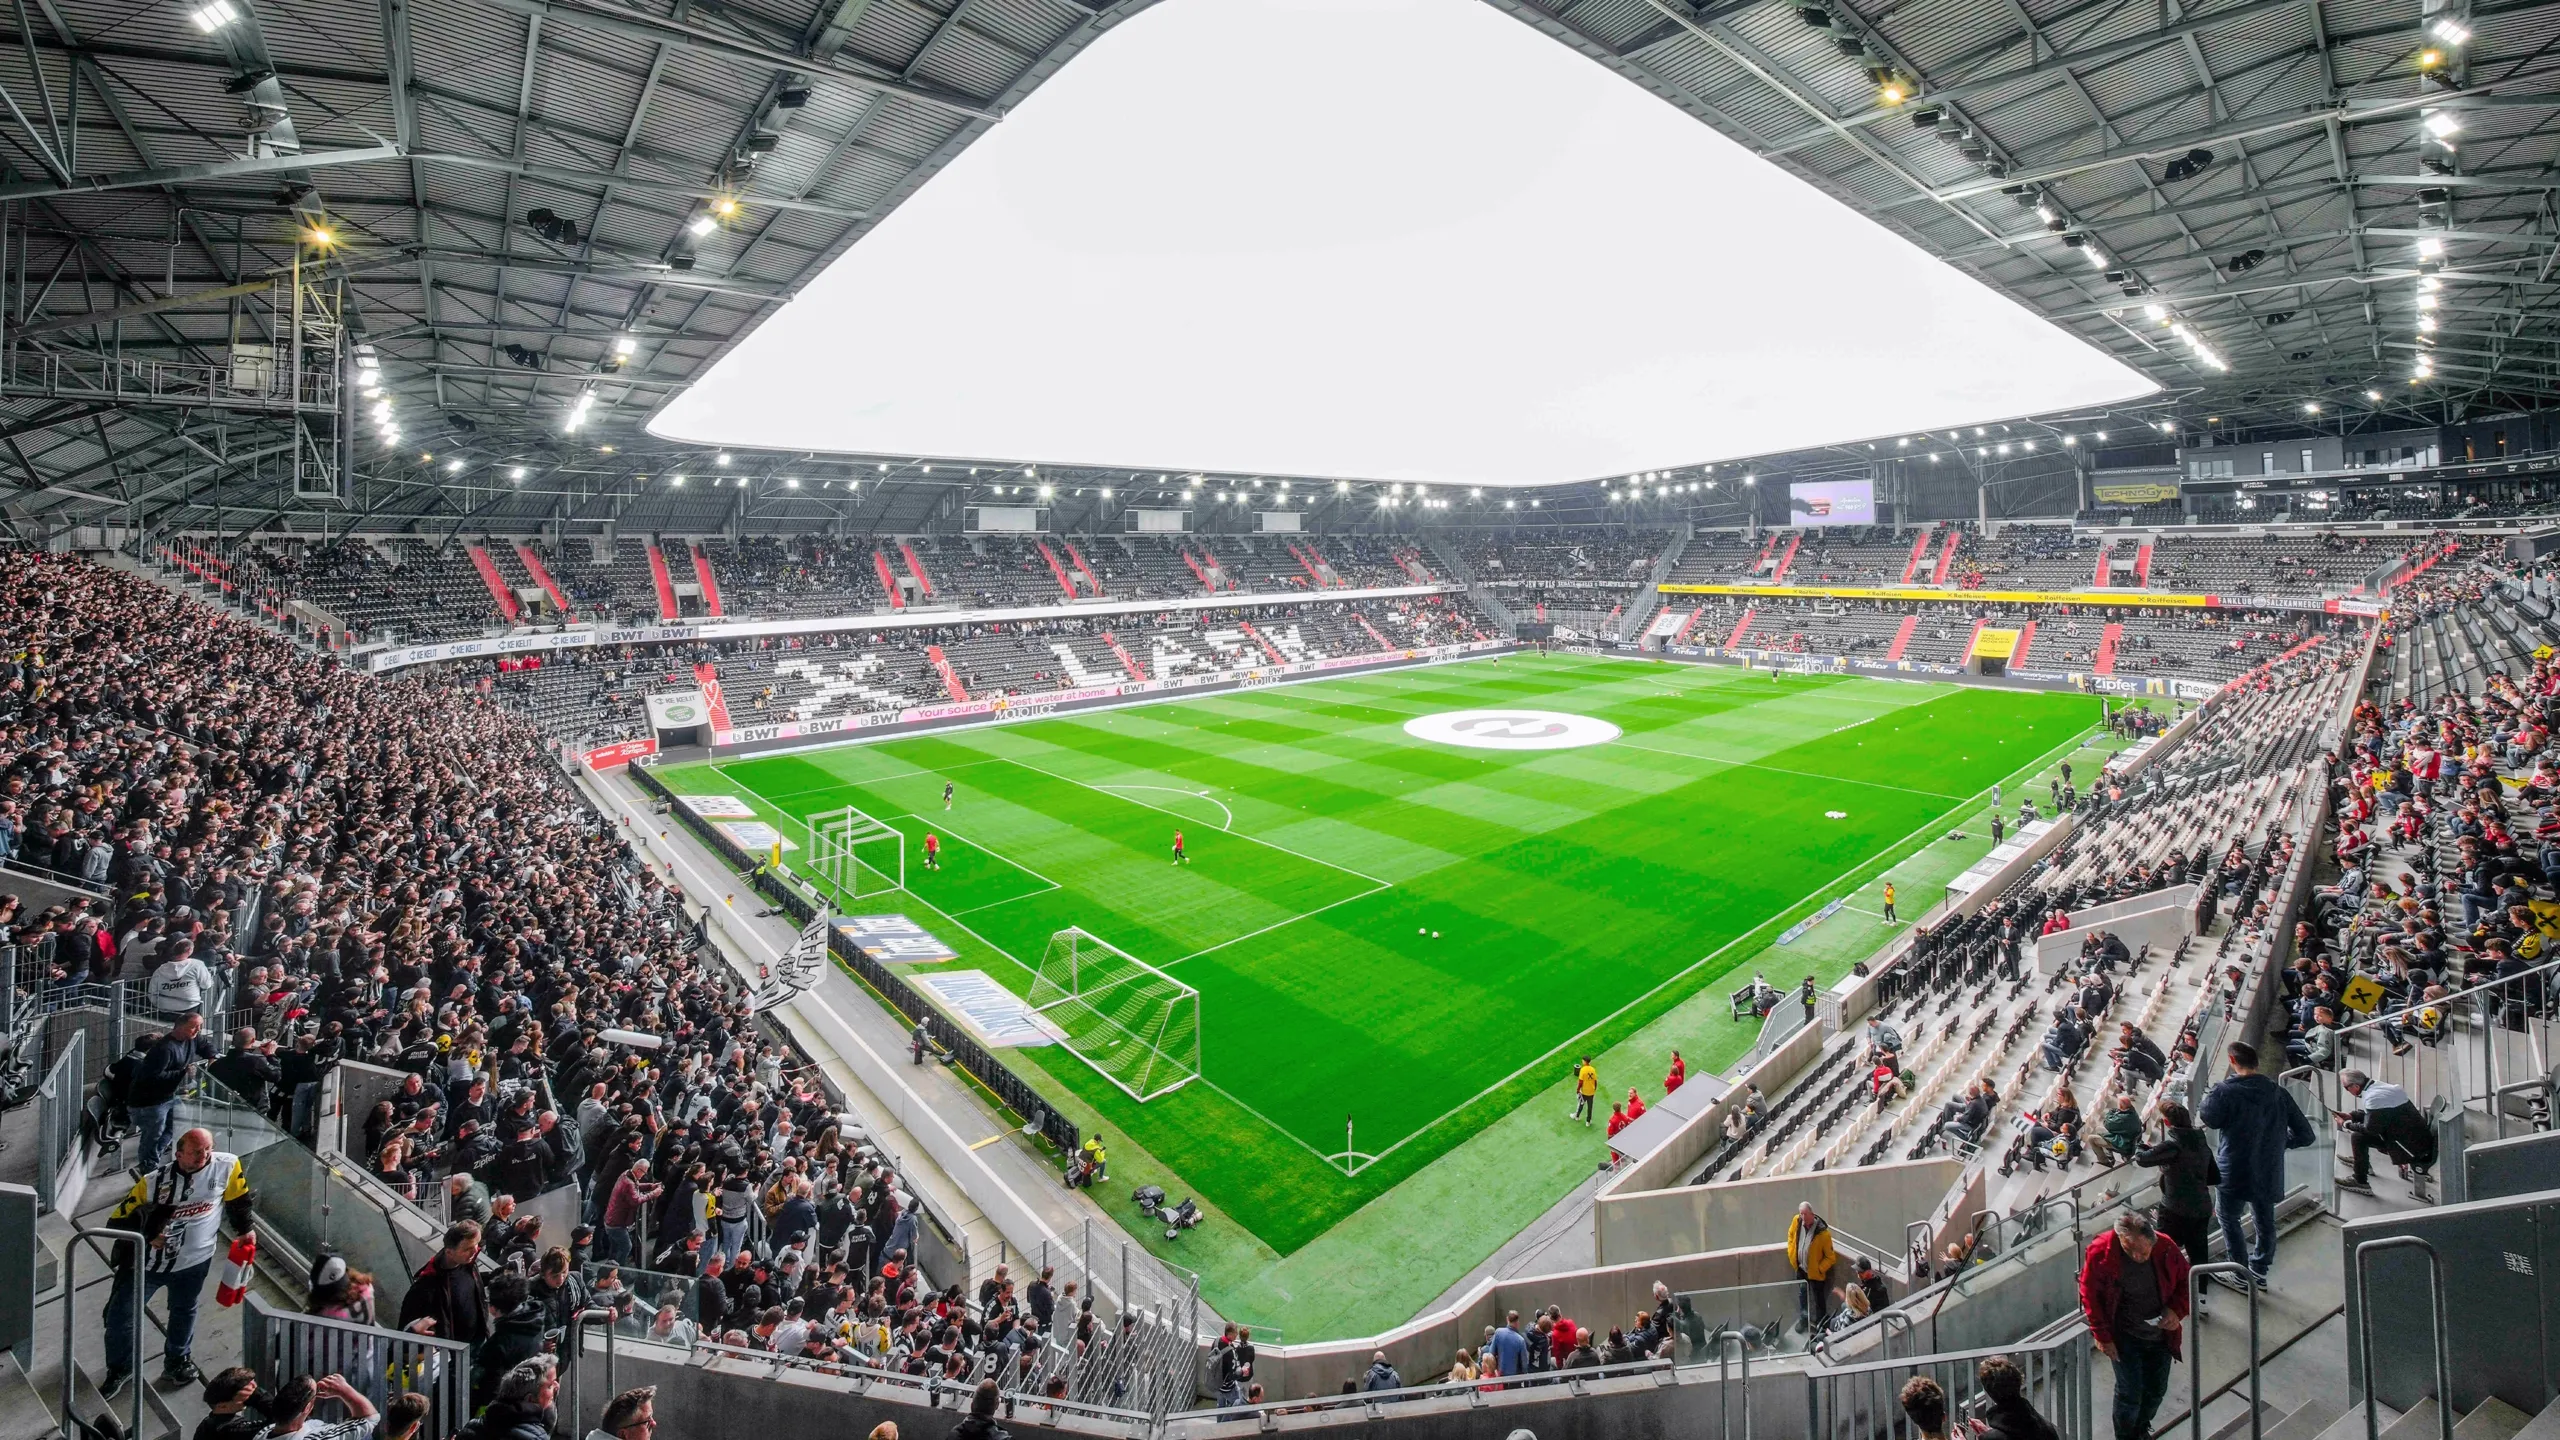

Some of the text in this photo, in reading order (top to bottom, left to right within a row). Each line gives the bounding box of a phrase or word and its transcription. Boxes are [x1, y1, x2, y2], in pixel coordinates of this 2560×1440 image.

[2218, 596, 2325, 609] FANKLUB SALZKAMMERGUT
[612, 631, 644, 641] BWT
[662, 628, 694, 638] BWT
[1299, 663, 1316, 672] BWT
[1324, 660, 1340, 668] Your
[1341, 657, 1363, 666] source
[1372, 654, 1385, 662] best
[1235, 671, 1253, 681] BWT
[1268, 666, 1286, 676] BWT
[1163, 679, 1184, 689] BWT
[1200, 675, 1220, 684] BWT
[2092, 677, 2138, 691] Zipfer
[1124, 683, 1146, 694] BWT
[2179, 683, 2217, 698] energie
[676, 695, 696, 703] KELIT
[917, 707, 944, 719] Your
[947, 703, 987, 715] source
[1008, 697, 1032, 707] best
[1035, 693, 1064, 704] water
[1066, 691, 1077, 700] at
[1078, 687, 1106, 698] home
[1031, 704, 1057, 717] LUCE
[871, 712, 901, 725] BWT
[810, 720, 843, 733] BWT
[744, 727, 780, 741] BWT
[161, 981, 191, 991] Zipfer
[473, 1154, 497, 1169] Zipfer
[173, 1203, 213, 1219] rnspitz
